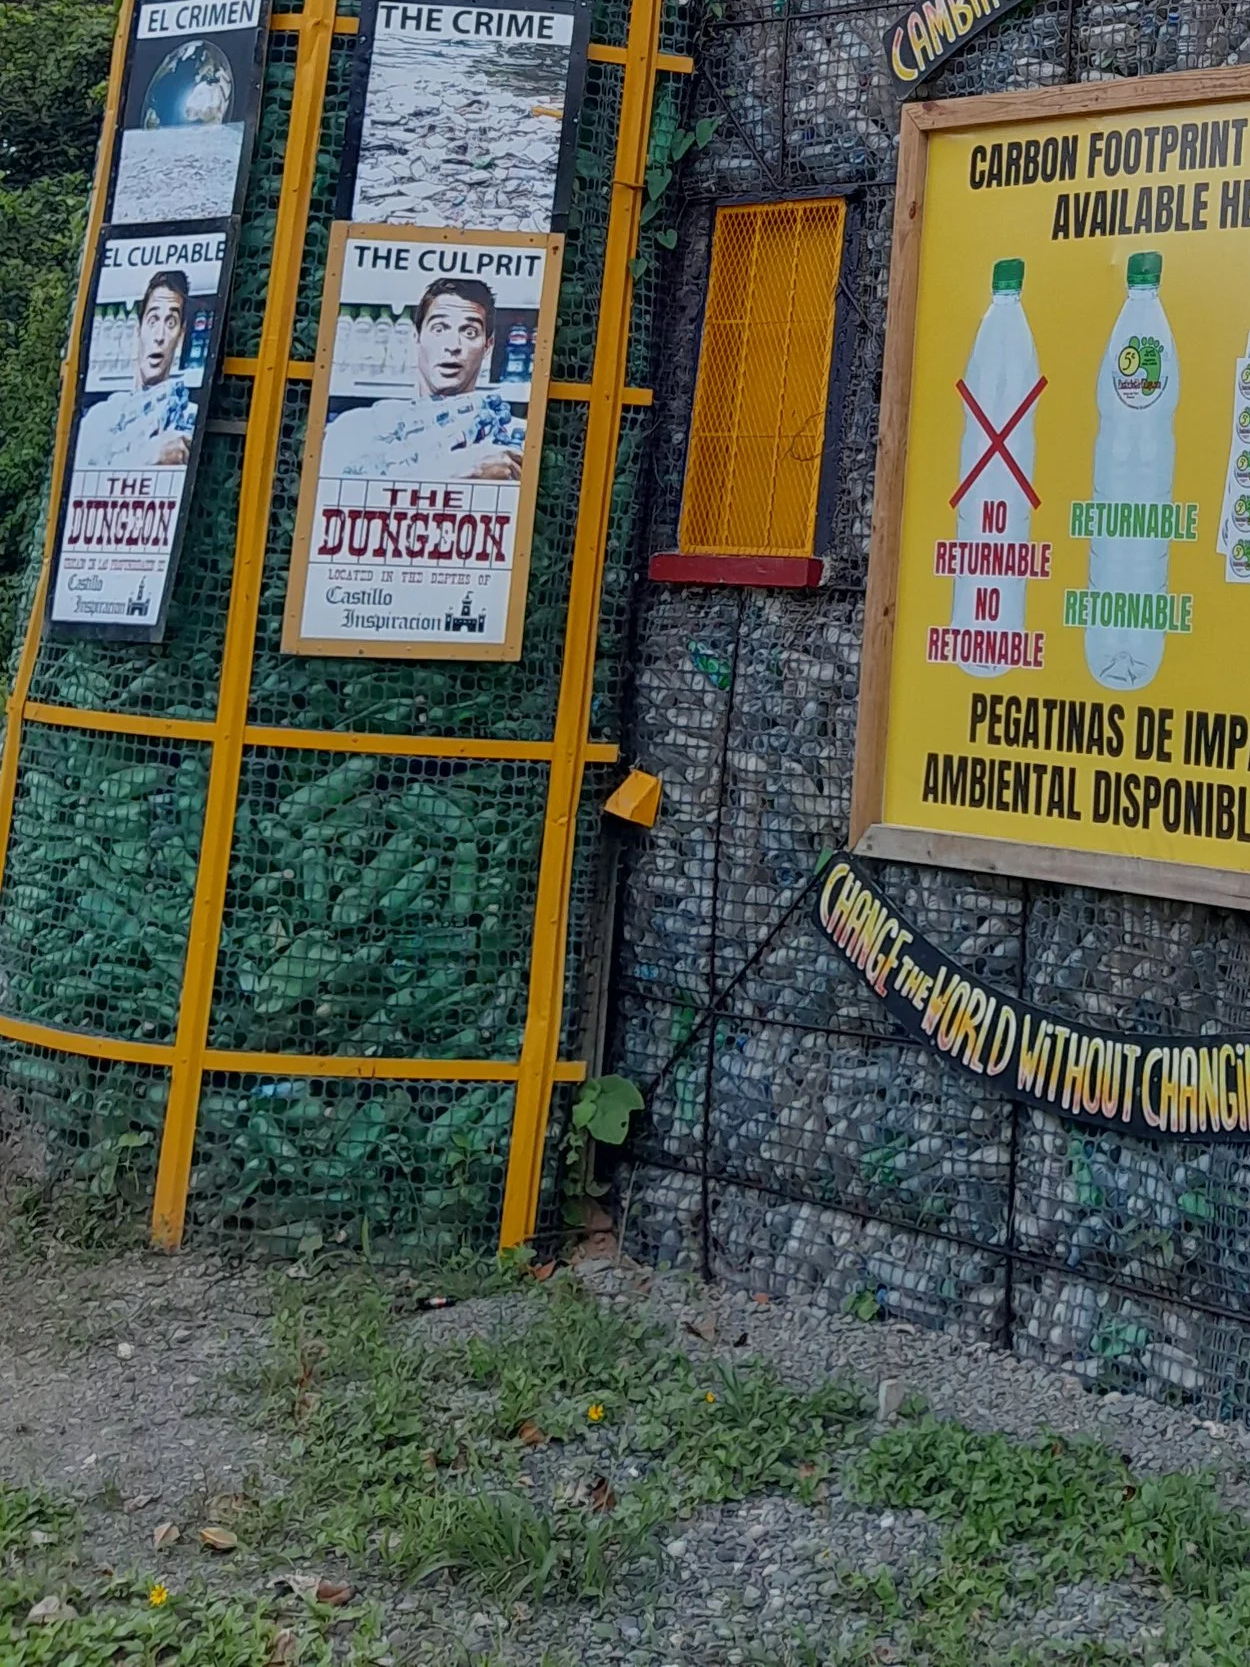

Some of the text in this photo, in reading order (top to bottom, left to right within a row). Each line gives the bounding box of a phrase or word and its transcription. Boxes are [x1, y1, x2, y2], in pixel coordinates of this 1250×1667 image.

[147, 0, 256, 33] EL CRIMEN
[379, 4, 555, 40] THE CRIME
[969, 136, 1078, 191] CARBON
[1087, 118, 1250, 179] FOOTPRINT
[1051, 182, 1209, 241] AVAILABLE
[103, 240, 226, 268] EL CULPABLE
[354, 245, 541, 277] THE CULPRIT
[107, 477, 152, 495] THE
[383, 488, 464, 509] THE
[67, 500, 176, 546] DUNGEON
[317, 508, 512, 562] DUNGEON
[981, 500, 1008, 534] NO
[1070, 501, 1198, 539] RETURNABLE
[328, 568, 491, 586] LOCATED IN THE DEPTHS OF
[934, 541, 1052, 579] RETURNABLE
[325, 585, 393, 606] Castillo
[975, 587, 1001, 622] NO
[1064, 589, 1193, 632] RETORNABLE
[340, 608, 442, 632] Inspiracion
[927, 627, 1045, 669] RETORNABLE
[968, 692, 1125, 758] PEGATINAS
[1134, 707, 1173, 763] DE
[922, 753, 1082, 822] AMBIENTAL
[818, 862, 914, 999] CHANGE
[893, 956, 933, 1011] THE
[921, 966, 1017, 1076] WORLD
